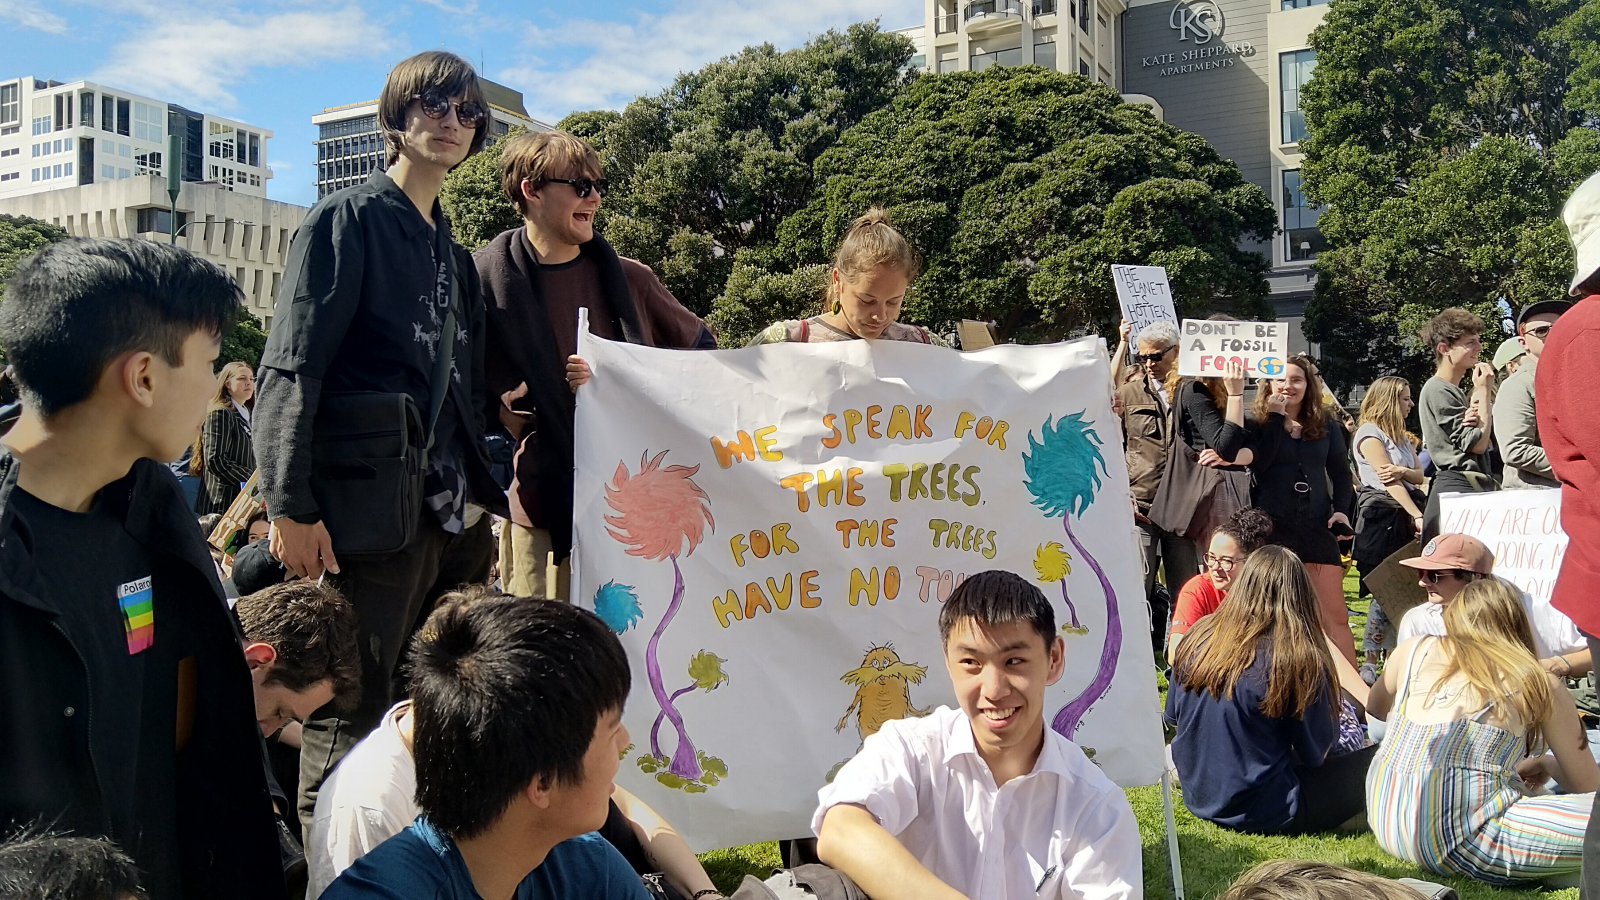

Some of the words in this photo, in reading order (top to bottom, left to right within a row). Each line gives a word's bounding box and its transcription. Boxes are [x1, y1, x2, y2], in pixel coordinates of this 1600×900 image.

[1142, 53, 1176, 67] KATE
[1181, 42, 1251, 61] SHEPPARD
[1160, 58, 1234, 76] APARTMENTS
[1114, 266, 1140, 282] THE
[1127, 281, 1165, 296] PLANET
[1132, 294, 1149, 306] IS
[1127, 304, 1172, 322] HOTTER
[1186, 321, 1240, 335] DON'T
[1255, 324, 1278, 337] BE
[1189, 338, 1206, 352] A
[1221, 339, 1277, 352] FOSSIL
[1200, 355, 1256, 371] FOOL
[710, 425, 783, 469] WE
[821, 404, 932, 449] SPEAK
[954, 411, 1009, 450] FOR
[780, 467, 866, 513] THE
[883, 461, 986, 506] TREES,
[1443, 508, 1491, 536] WHY
[1499, 507, 1537, 536] ARE
[730, 523, 799, 567] FOR
[836, 518, 898, 548] THE
[929, 518, 997, 559] TREES
[1494, 541, 1543, 571] DOING
[712, 570, 822, 628] HAVE
[849, 565, 901, 606] NO
